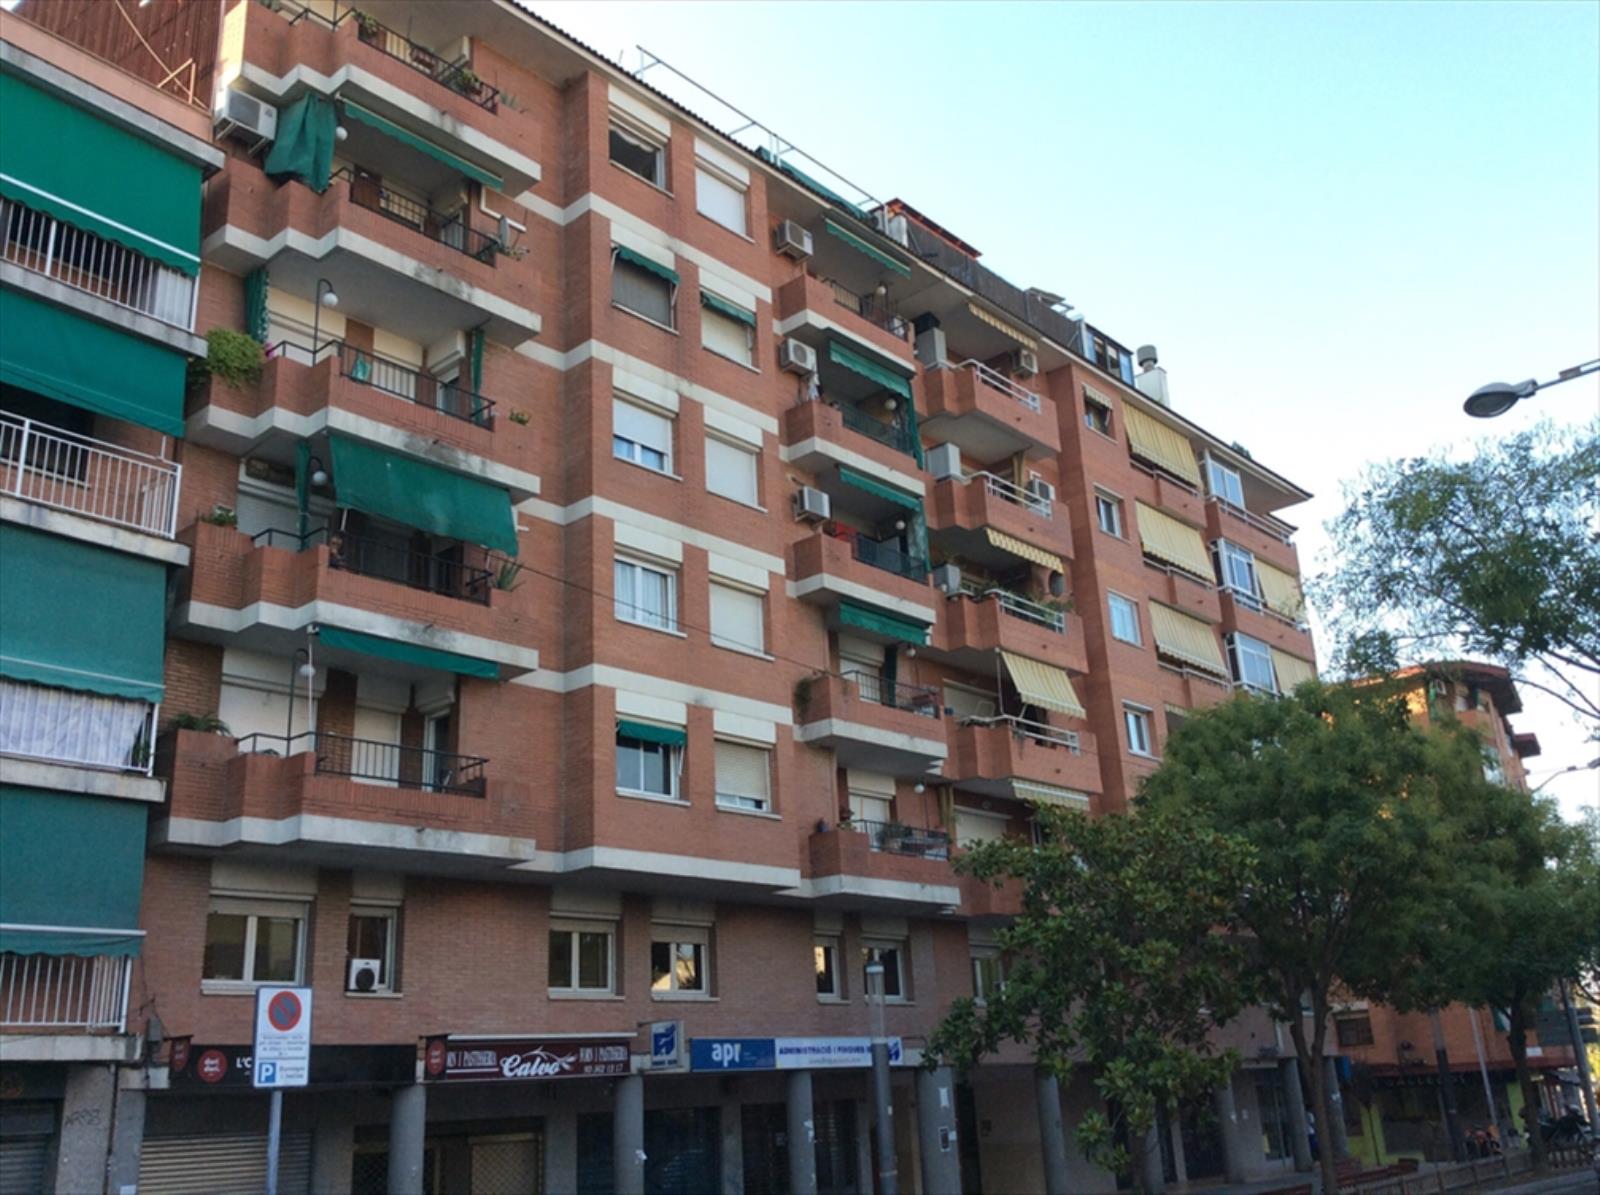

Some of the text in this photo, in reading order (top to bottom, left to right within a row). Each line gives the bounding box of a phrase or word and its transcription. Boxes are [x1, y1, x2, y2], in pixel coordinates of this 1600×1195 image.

[499, 1053, 560, 1078] Calvo
[711, 1042, 742, 1068] apr
[260, 1063, 274, 1083] P
